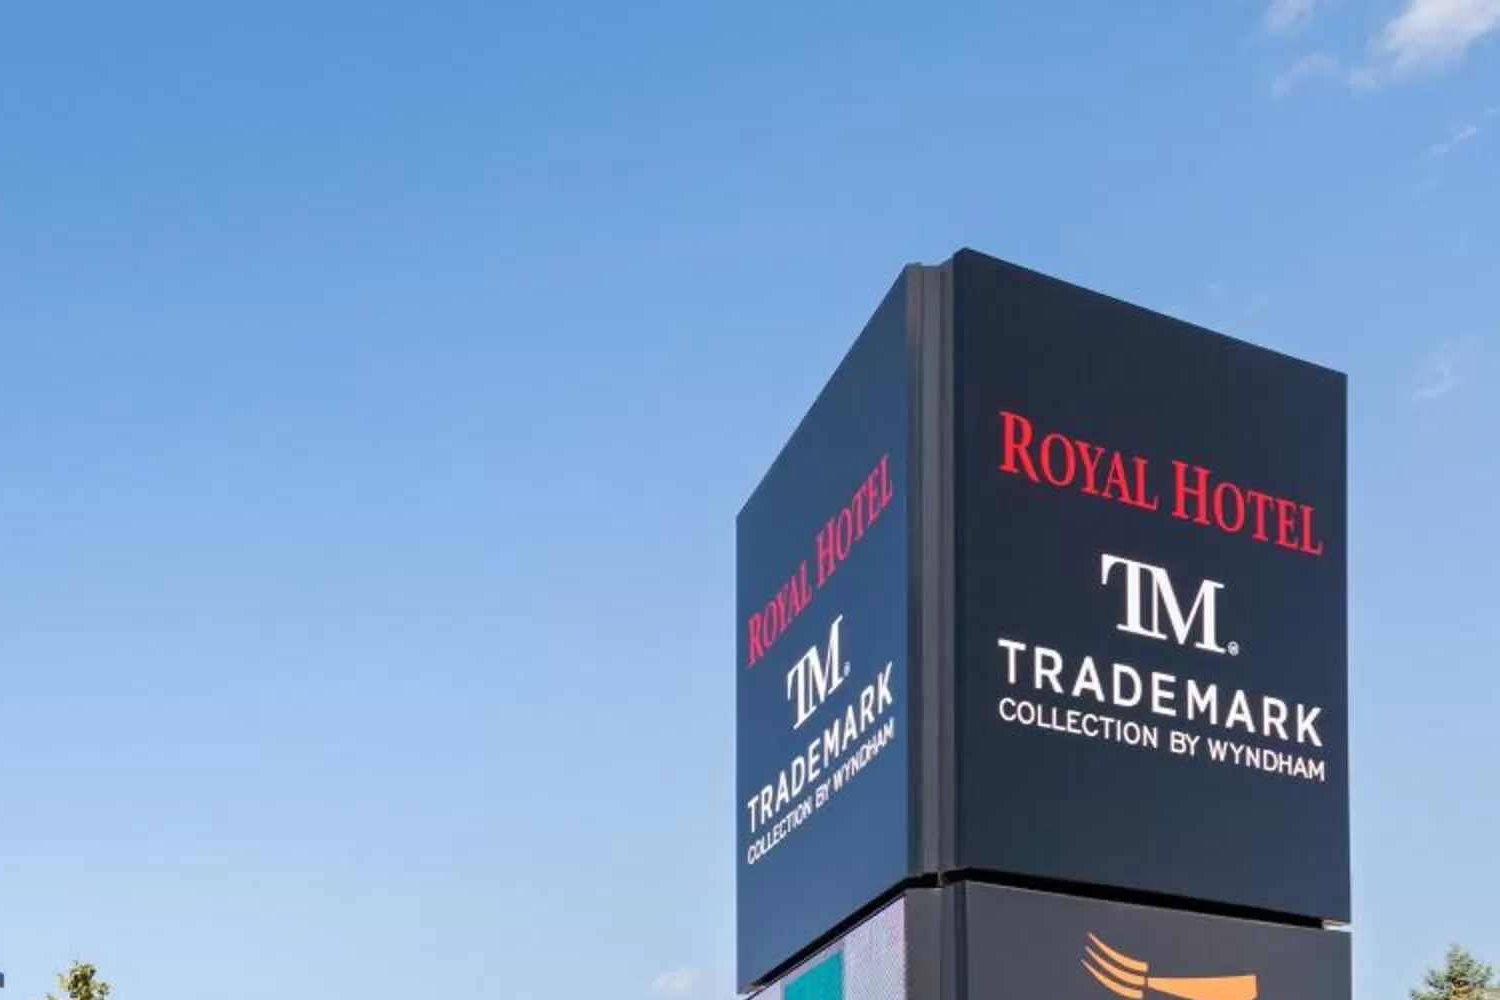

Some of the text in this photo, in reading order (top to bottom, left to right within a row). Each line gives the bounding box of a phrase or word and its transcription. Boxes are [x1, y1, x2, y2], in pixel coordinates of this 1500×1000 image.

[1000, 411, 1323, 556] ROYAL HOTEL
[747, 454, 893, 666] ROYAL HOTEL
[747, 661, 893, 833] TRADEMARK
[998, 638, 1323, 747] TRADEMARK
[999, 697, 1325, 782] COLLECTION BY WYNDHAM
[748, 718, 894, 864] COLLECTION BY WYNDHAM
